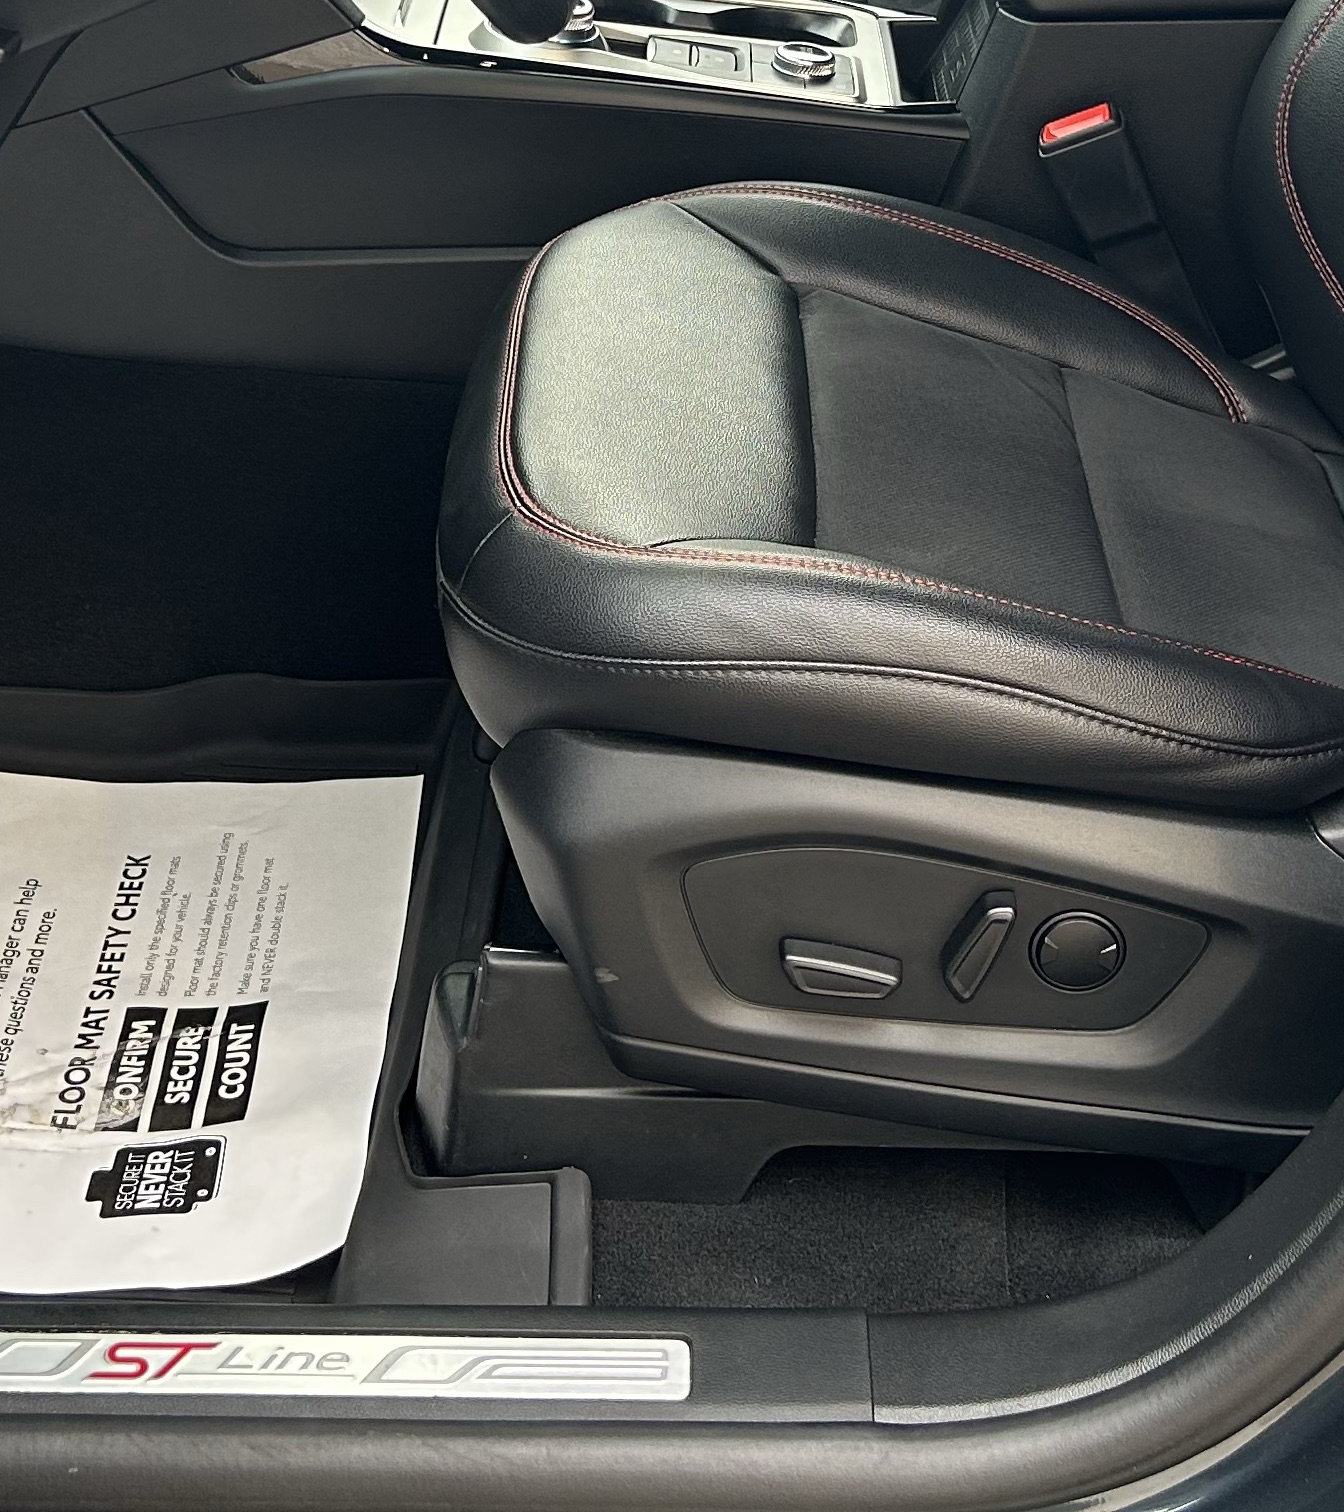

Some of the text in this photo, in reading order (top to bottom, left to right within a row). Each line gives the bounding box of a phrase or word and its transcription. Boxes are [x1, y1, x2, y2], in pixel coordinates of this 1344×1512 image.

[13, 877, 42, 906] help
[225, 893, 238, 911] clips
[231, 883, 239, 892] or
[274, 892, 287, 914] stack
[8, 899, 29, 933] can
[34, 908, 57, 946] more.
[136, 856, 181, 996] Install only the specified floor mats
[184, 832, 234, 997] Floor mat should always be secured using
[218, 912, 233, 950] retention
[237, 858, 275, 994] Make sure you have one floor mat
[269, 916, 283, 945] double
[165, 944, 178, 956] for
[172, 924, 184, 943] your
[26, 948, 45, 975] and
[157, 959, 175, 996] designed
[208, 951, 228, 980] factory
[261, 948, 276, 975] NEVER
[50, 853, 152, 1130] FLOOR MAT SAFETY CHECK
[206, 982, 218, 996] the
[259, 978, 271, 993] and
[4, 976, 36, 1036] questions
[111, 1020, 156, 1114] CONFIRM
[164, 1026, 204, 1104] SECURE
[217, 1022, 255, 1099] COUNT
[114, 1152, 146, 1210] SECURE IT
[134, 1150, 174, 1208] NEVER
[162, 1150, 195, 1208] STACK IT
[86, 1341, 350, 1380] ST Line
